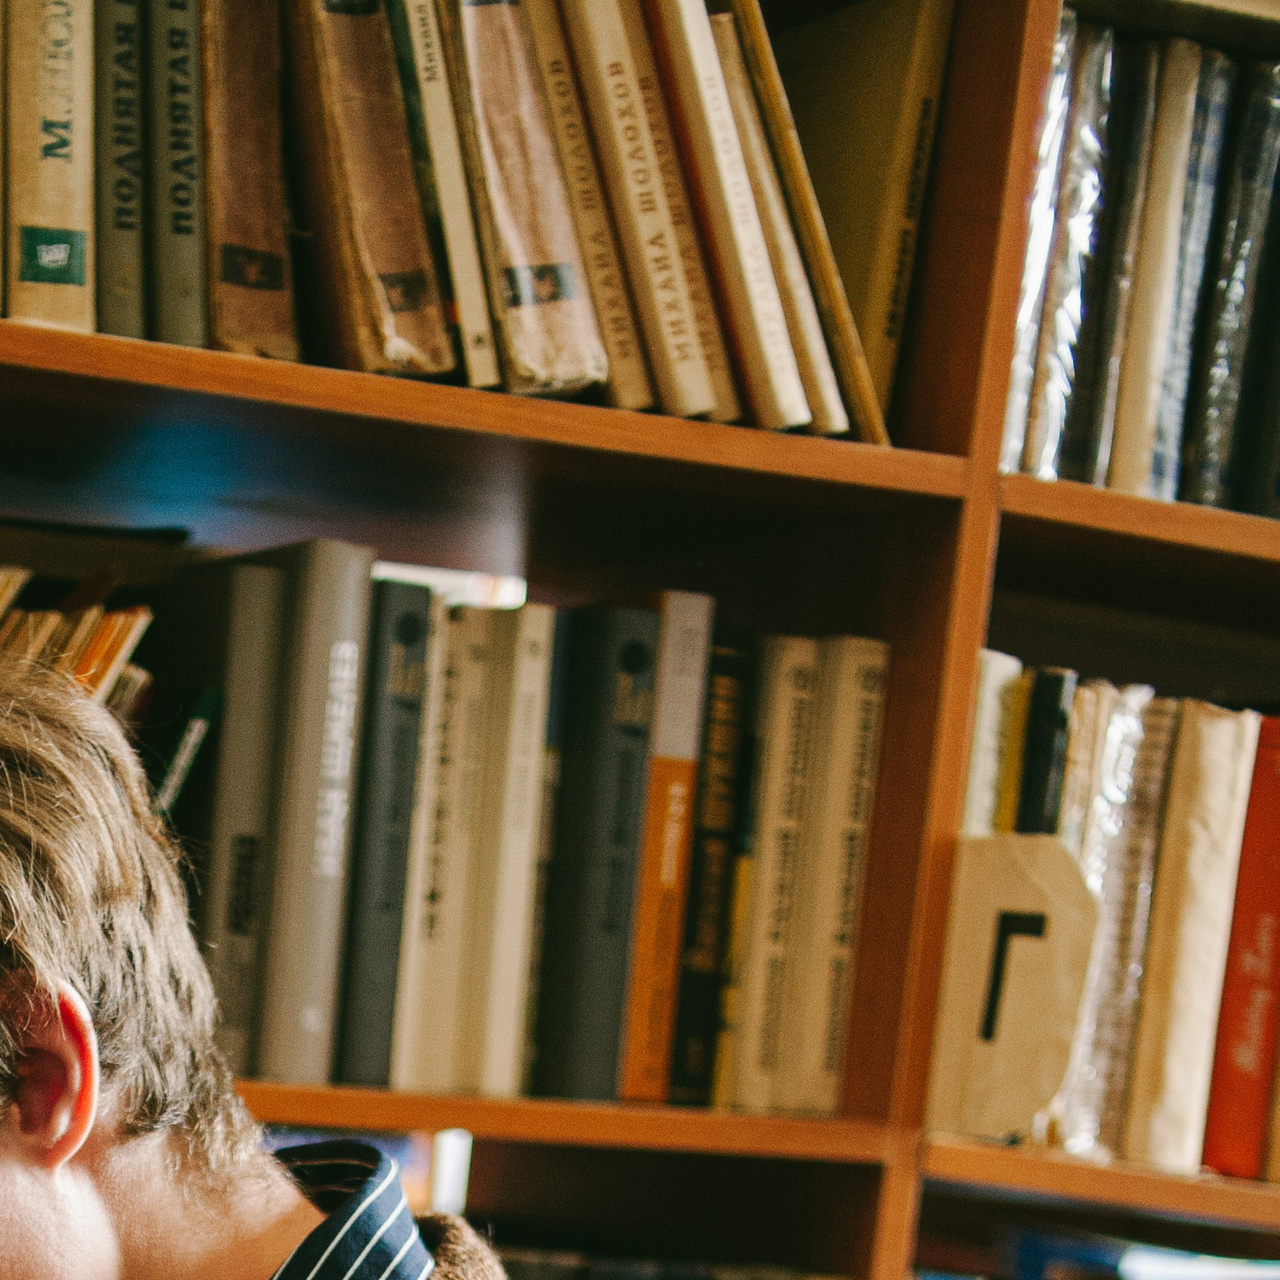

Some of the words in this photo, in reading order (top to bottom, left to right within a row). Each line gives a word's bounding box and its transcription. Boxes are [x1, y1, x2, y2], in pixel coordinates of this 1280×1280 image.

[113, 22, 141, 232] ПОДНЯТАЯ
[167, 27, 198, 236] ПОДНЯТАЯ
[547, 60, 597, 211] ШОЛОХОВ
[605, 61, 658, 214] ШОЛОХОВ
[589, 231, 632, 358] МИХАИЛ
[646, 233, 691, 363] МИХАИЛ
[980, 911, 1047, 1042] Г
